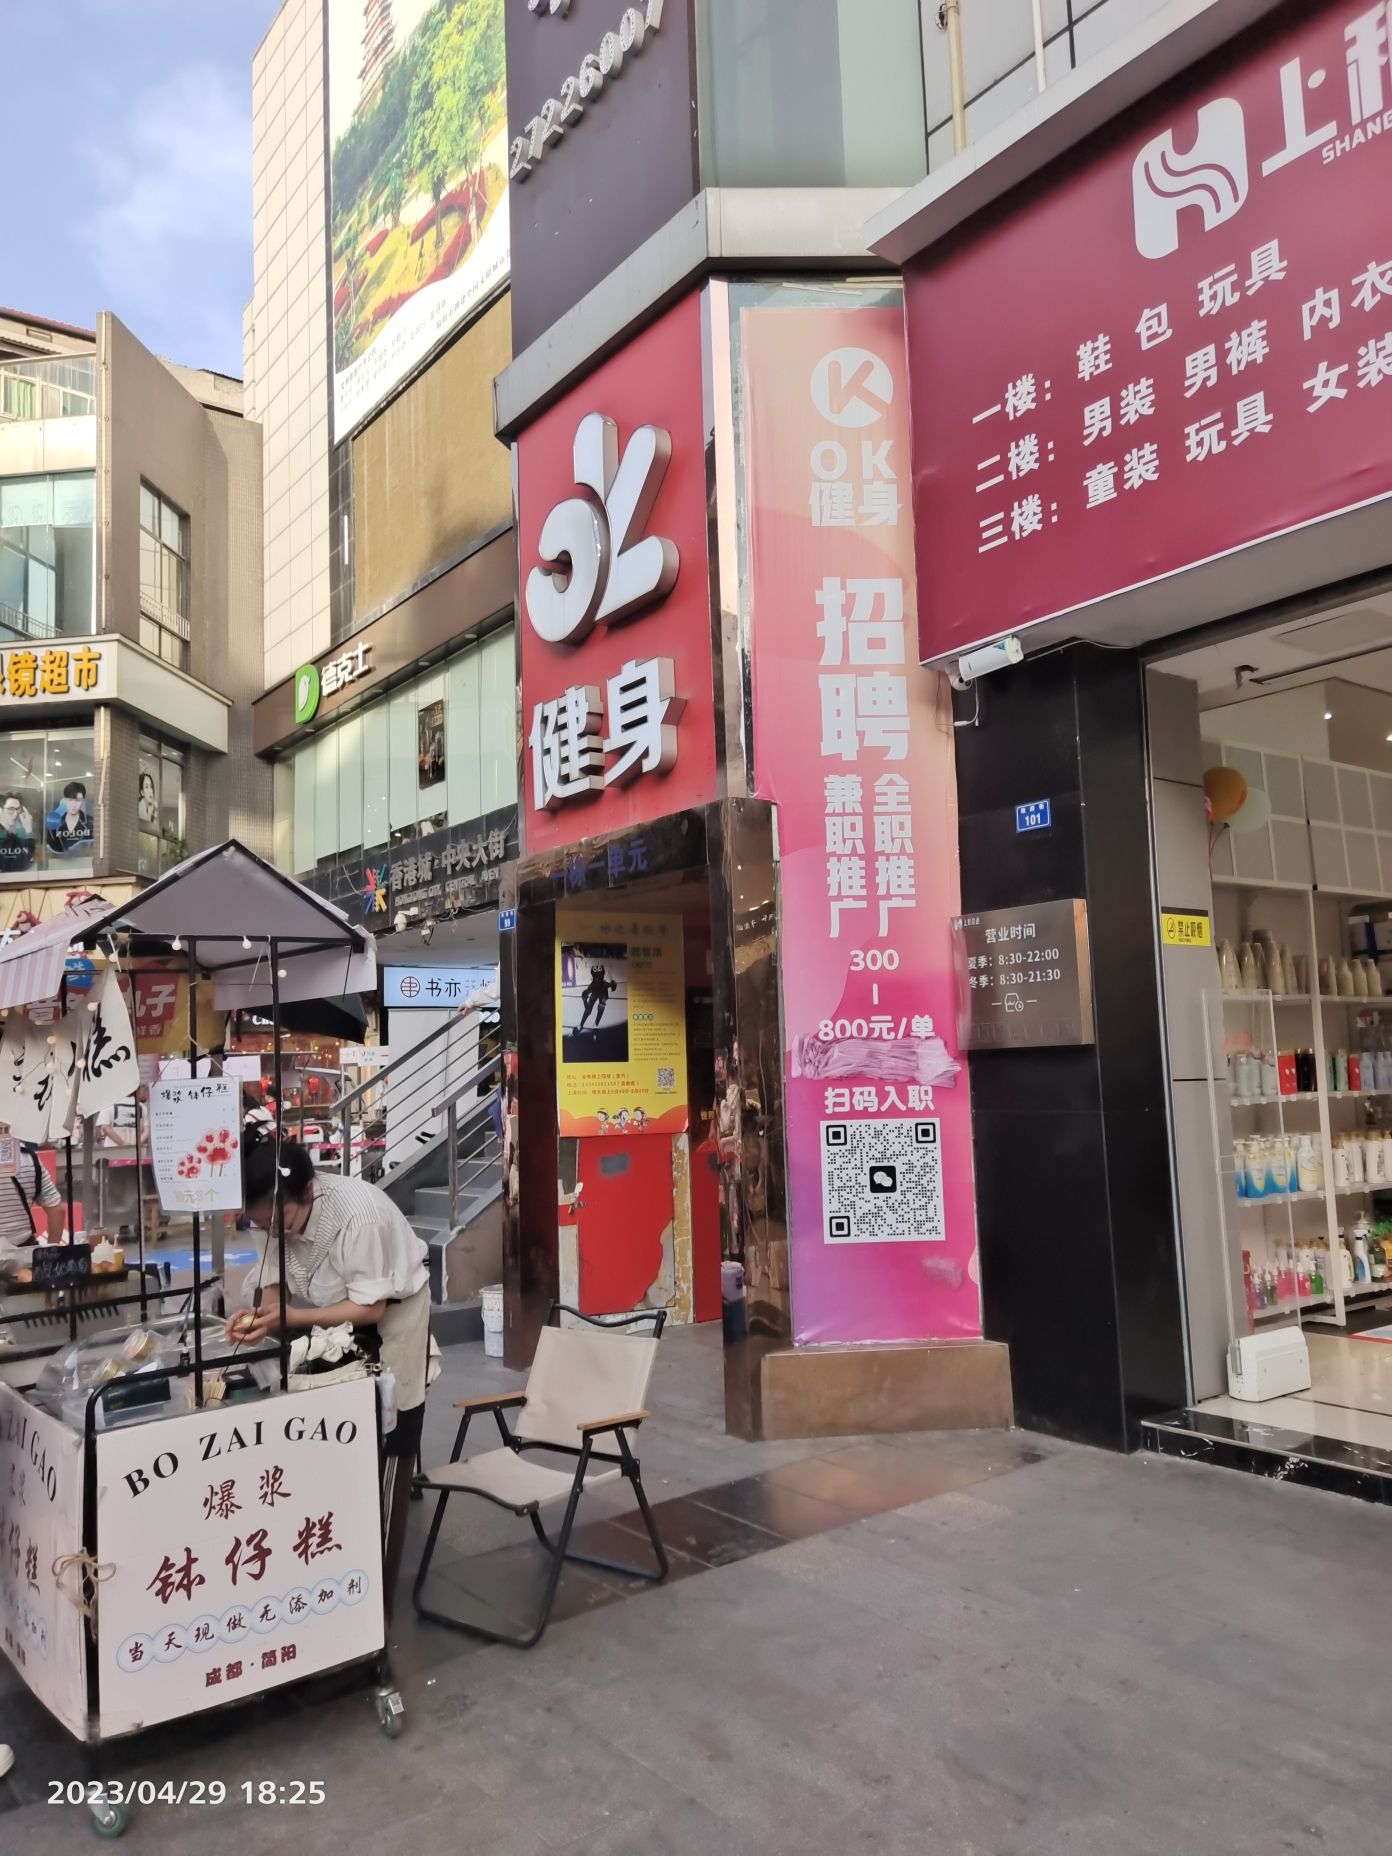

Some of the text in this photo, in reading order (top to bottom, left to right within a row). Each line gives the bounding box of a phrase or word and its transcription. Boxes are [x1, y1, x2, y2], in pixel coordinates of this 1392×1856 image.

[973, 373, 1051, 423] 一楼：
[1198, 238, 1288, 316] 玩具
[976, 434, 1055, 492] 二楼：
[1082, 377, 1156, 445] 男装
[1184, 320, 1270, 398] 男裤
[808, 481, 902, 527] 健身
[978, 494, 1057, 553] 三楼：
[1082, 443, 1159, 509] 童装
[1185, 391, 1273, 463] 玩具
[0, 646, 101, 697] 镜超市
[815, 576, 910, 762] 招聘
[528, 657, 688, 810] 健身
[873, 773, 916, 938] 全职推广
[1025, 813, 1041, 826] 101
[824, 774, 868, 938] 兼职推广
[850, 950, 899, 971] 300
[985, 923, 1036, 944] 营业时间
[998, 948, 1059, 966] 8:30-22:00
[999, 969, 1061, 985] 8:30-21:30
[819, 1015, 935, 1042] 800元/单
[824, 1085, 935, 1115] 扫码入职
[30, 1430, 57, 1502] GAO
[122, 1416, 358, 1498] BO ZAI GAO
[202, 1465, 291, 1520] 爆浆
[146, 1511, 343, 1605] 钵仔糕
[128, 1577, 363, 1662] 当天现做无添加剂
